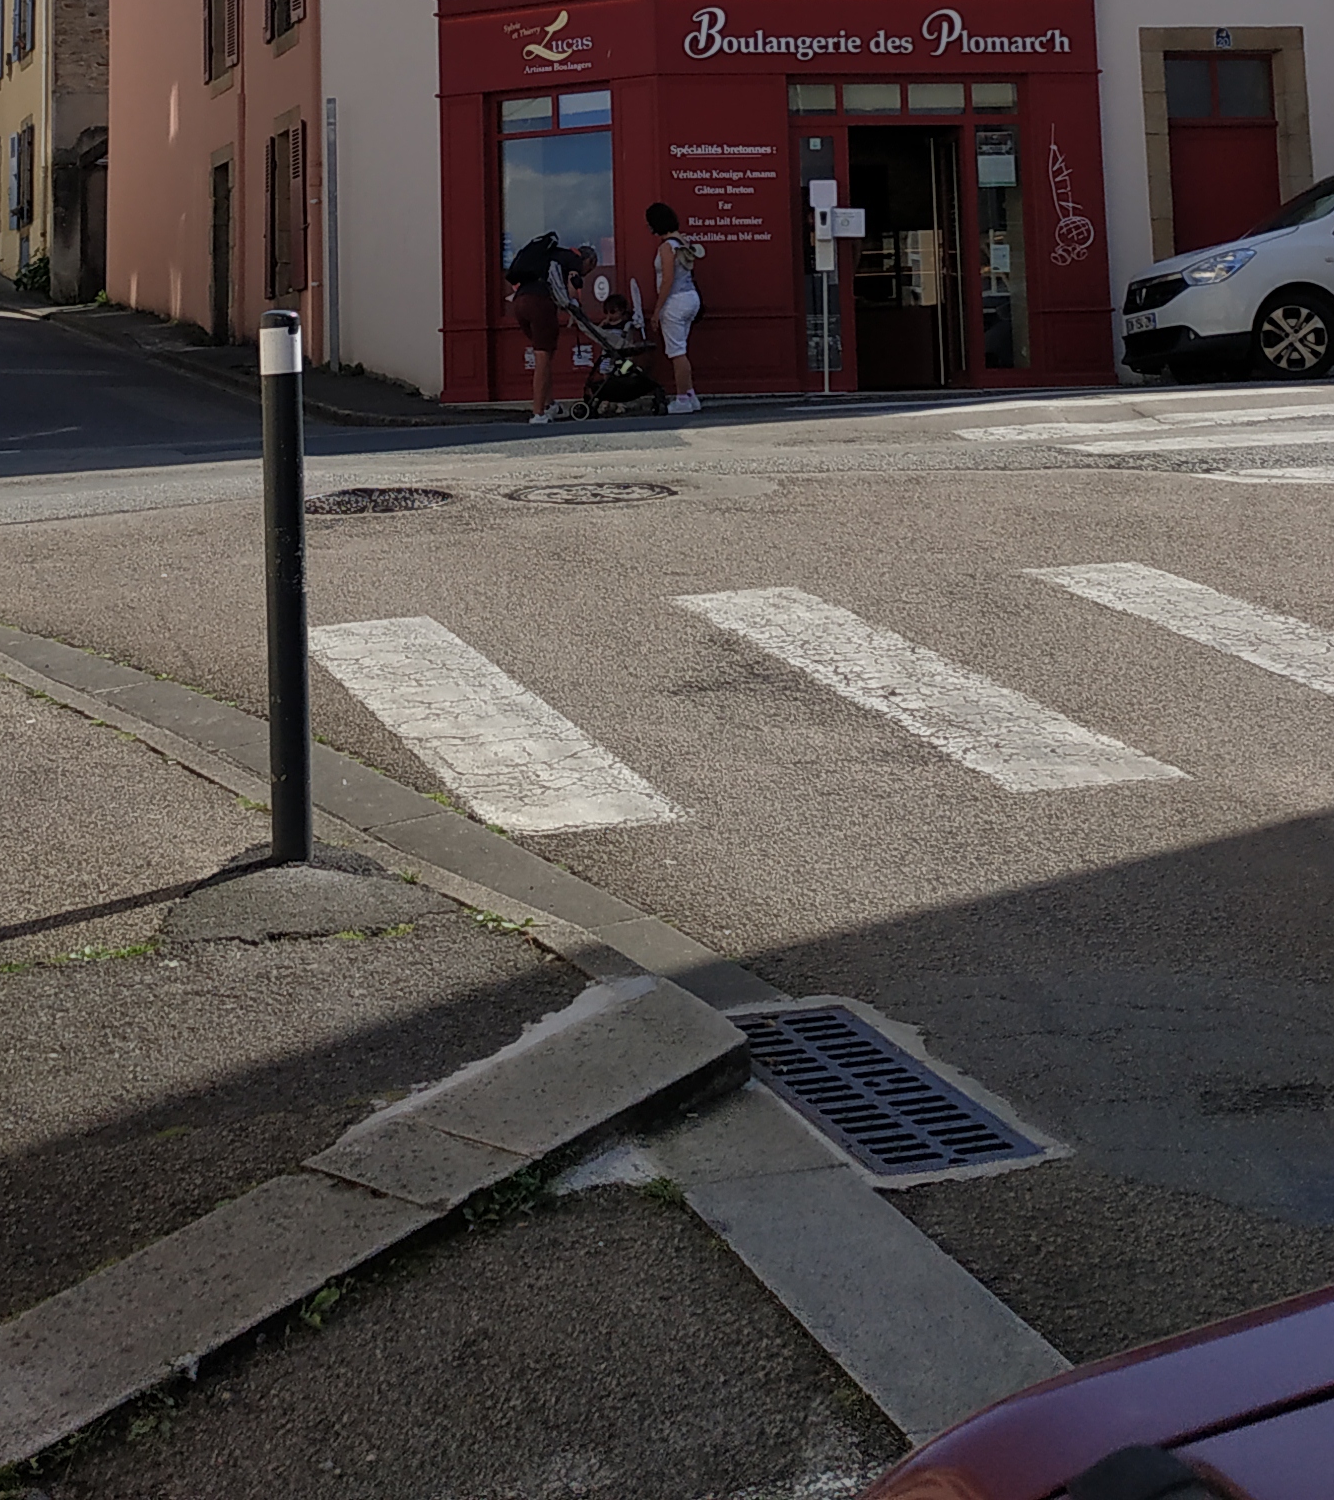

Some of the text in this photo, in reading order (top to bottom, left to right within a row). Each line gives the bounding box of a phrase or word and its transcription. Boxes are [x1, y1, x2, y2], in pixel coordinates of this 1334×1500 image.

[523, 10, 593, 61] Lucas
[683, 6, 1071, 61] Boulangerie des Plomarc'h
[524, 61, 592, 74] Artisans Boulangers
[670, 144, 722, 158] Spécialités
[723, 144, 771, 154] bretonnes
[671, 169, 777, 180] Véritable Kouign Amann
[694, 185, 755, 194] Gâteau Breton
[718, 201, 733, 209] Far
[688, 217, 703, 225] Riz
[716, 216, 731, 225] lait
[732, 216, 763, 225] fermier
[738, 232, 752, 241] blé
[753, 232, 772, 241] noir
